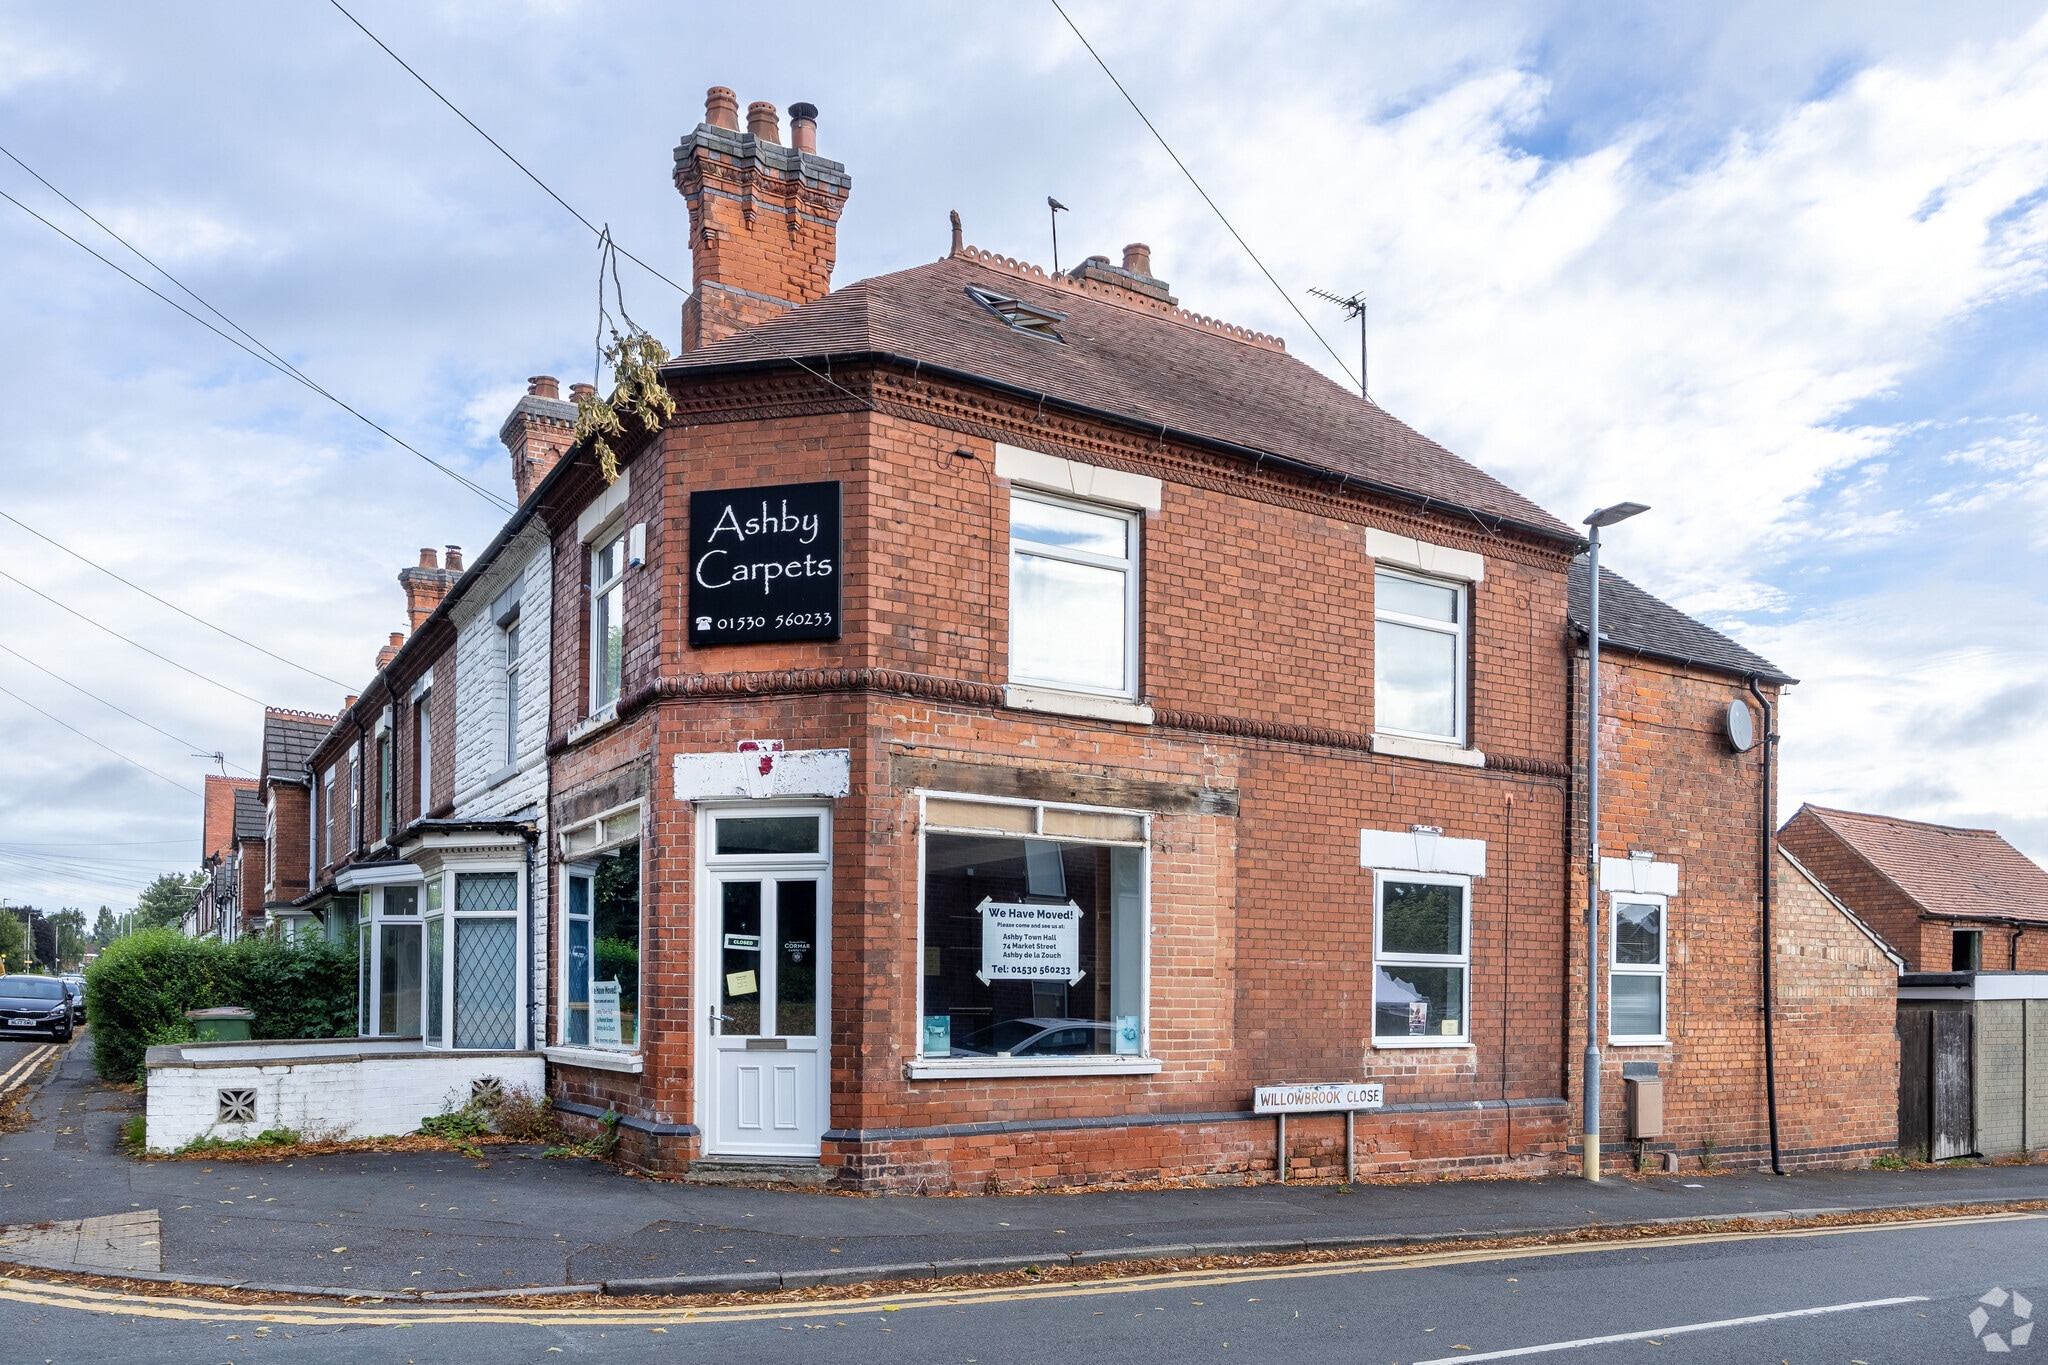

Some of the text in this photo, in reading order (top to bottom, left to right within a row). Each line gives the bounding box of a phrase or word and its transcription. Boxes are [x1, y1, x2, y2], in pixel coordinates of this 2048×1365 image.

[707, 499, 819, 544] Ashby
[695, 549, 833, 595] Carpets
[717, 612, 832, 631] 01530 560233
[988, 907, 1074, 920] We Have Moved!
[1002, 933, 1023, 941] Ashby
[1002, 951, 1023, 959] Ashby
[991, 964, 1071, 975] Tel: 01530 560233
[1260, 1089, 1380, 1107] WILLOWBROOK CLOSE
